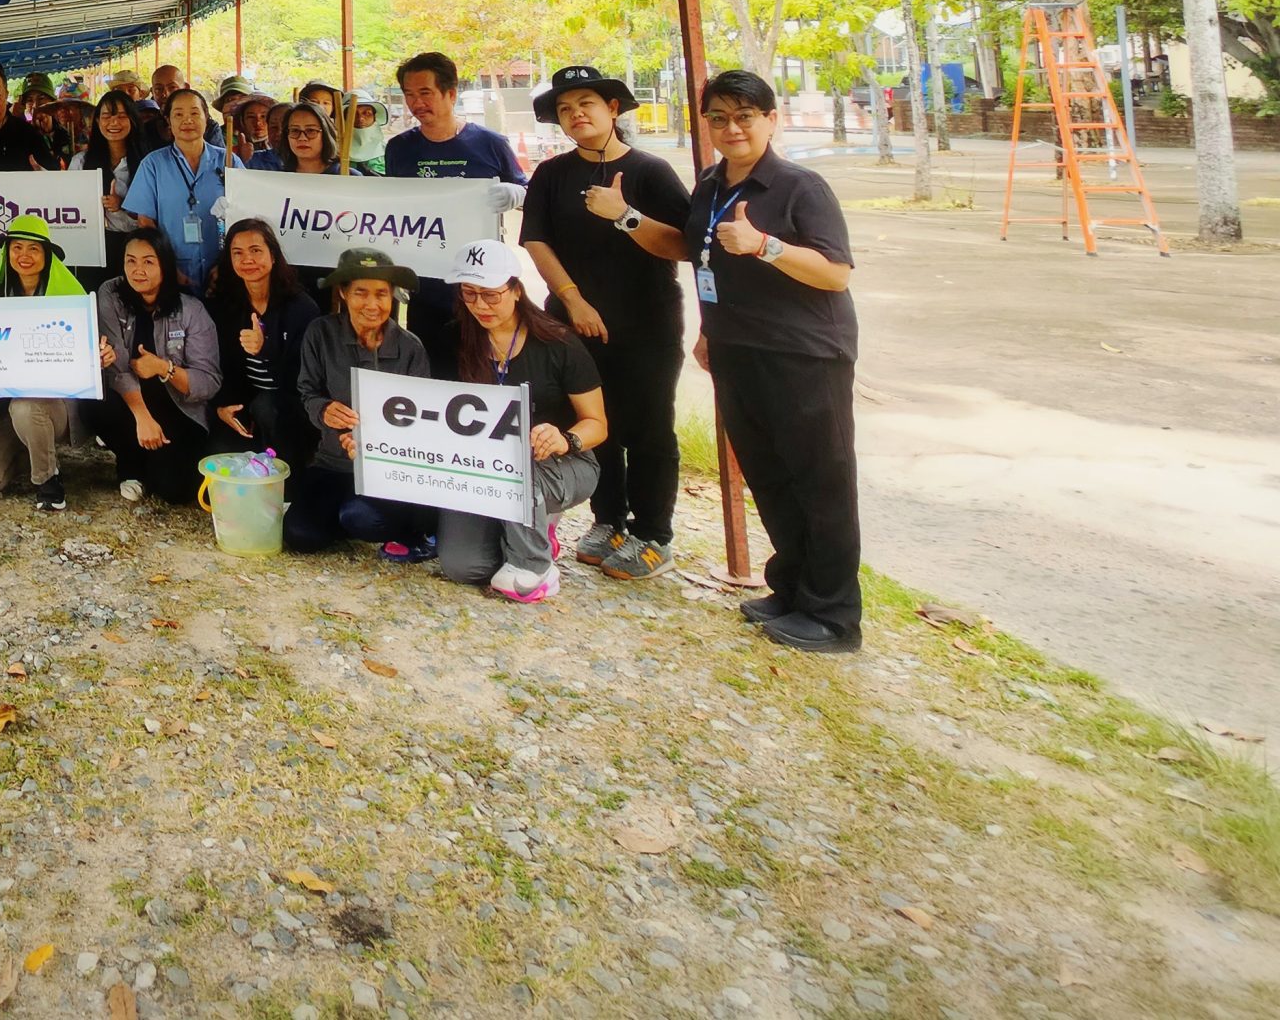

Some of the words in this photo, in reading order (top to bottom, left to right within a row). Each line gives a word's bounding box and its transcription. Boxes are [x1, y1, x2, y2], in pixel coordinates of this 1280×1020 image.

[279, 197, 446, 241] INDORAMA
[279, 230, 446, 249] VENTURES
[21, 333, 75, 349] TPRC
[382, 393, 522, 441] e-CA
[365, 442, 444, 464] e-Coatings
[451, 453, 485, 469] Asia
[384, 470, 413, 483] บริษัท
